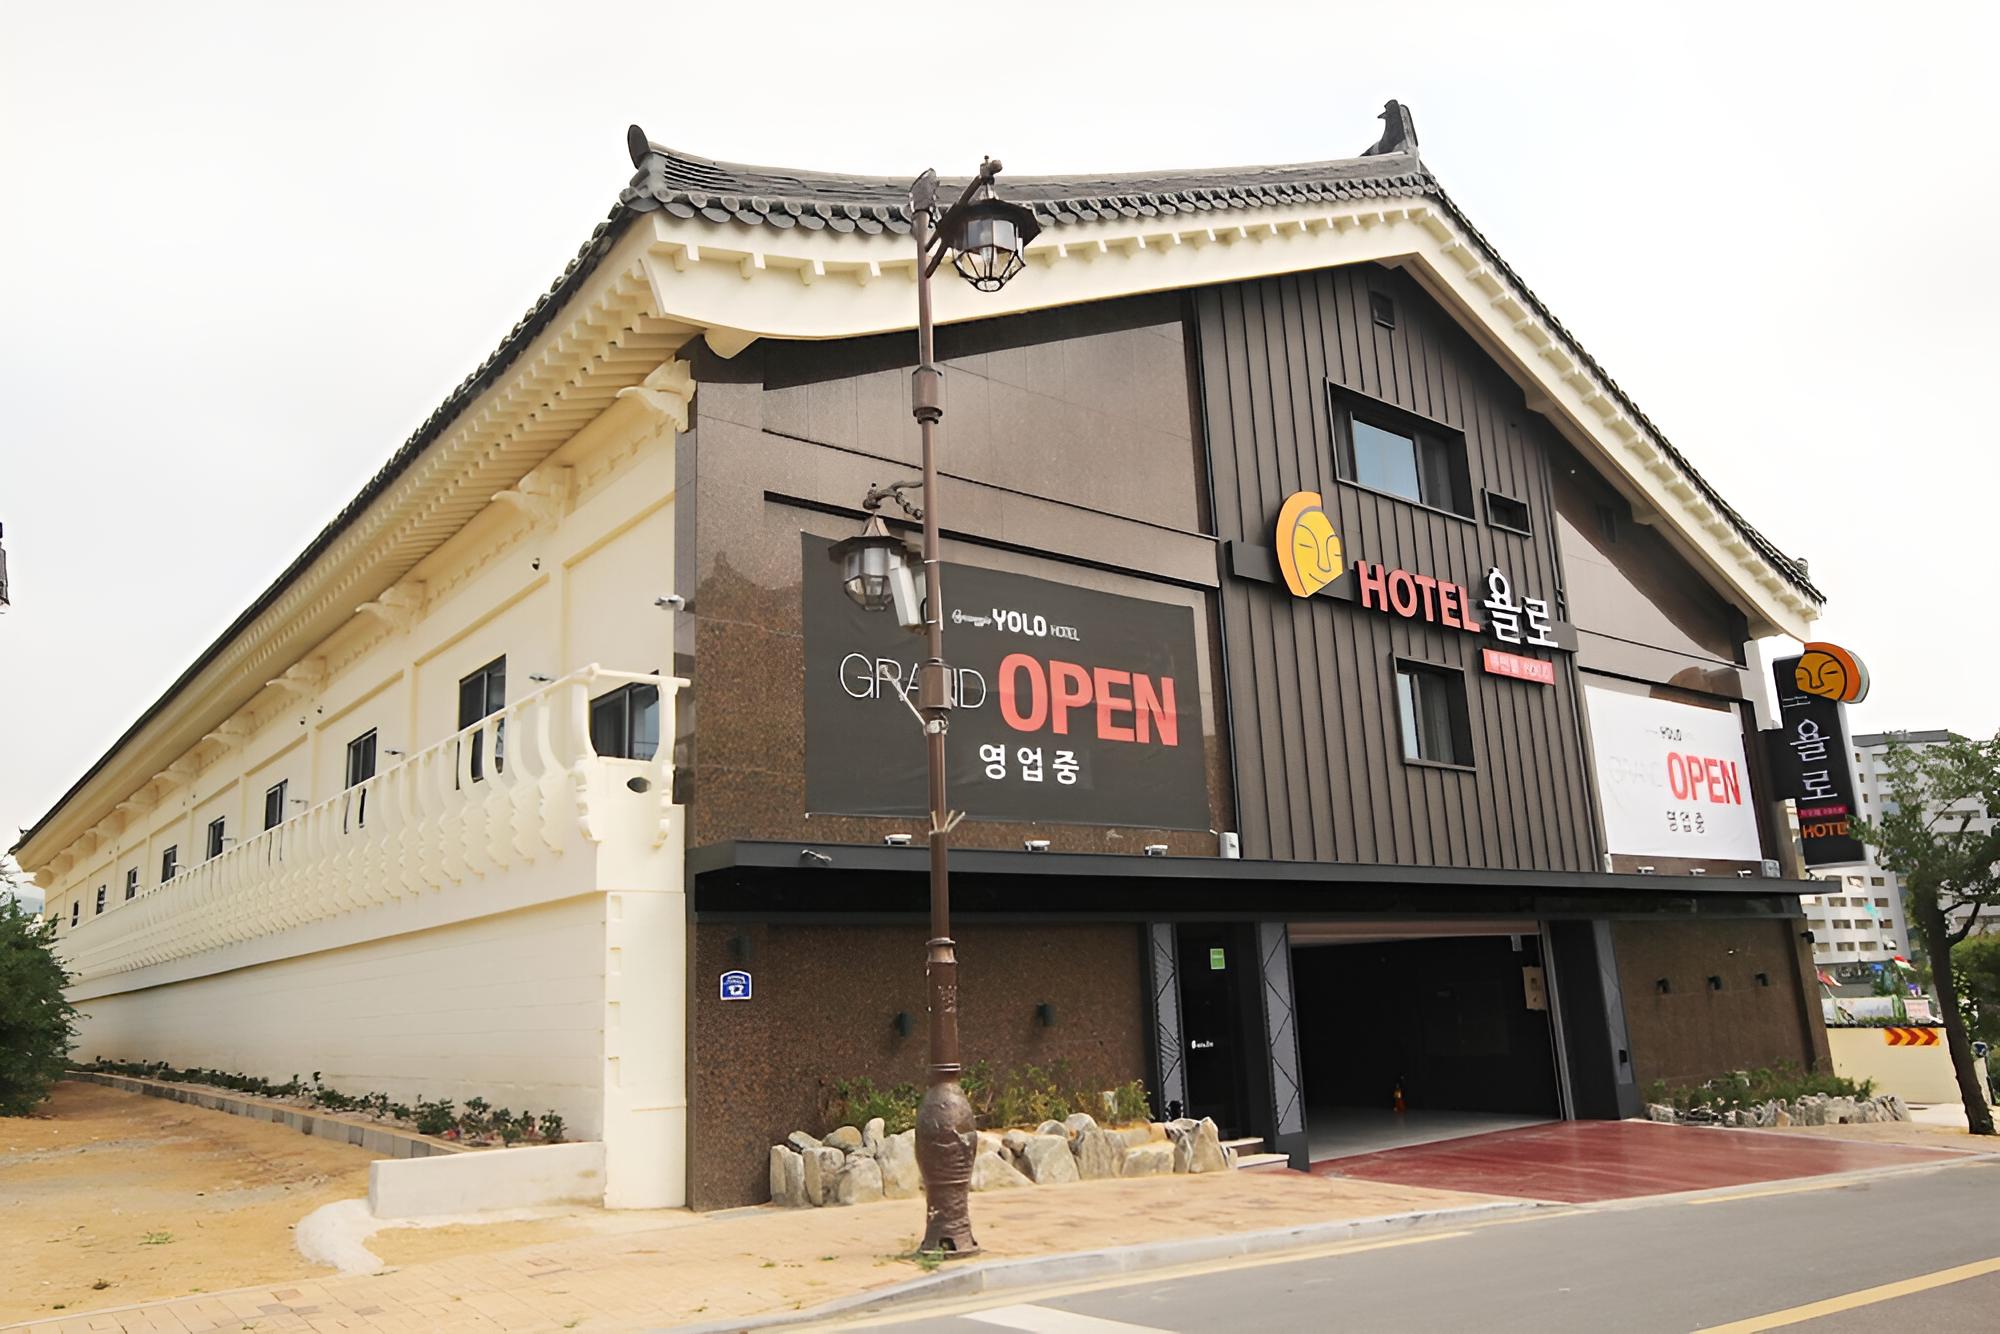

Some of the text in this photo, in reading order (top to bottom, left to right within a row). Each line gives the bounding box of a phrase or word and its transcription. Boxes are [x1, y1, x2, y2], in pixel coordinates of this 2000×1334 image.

[992, 608, 1047, 637] YOLO
[1354, 560, 1559, 648] HOTEL 욜로
[998, 652, 1178, 747] OPEN
[1666, 751, 1742, 806] OPEN
[1789, 718, 1838, 801] 욜로
[1802, 821, 1850, 839] HOTE
